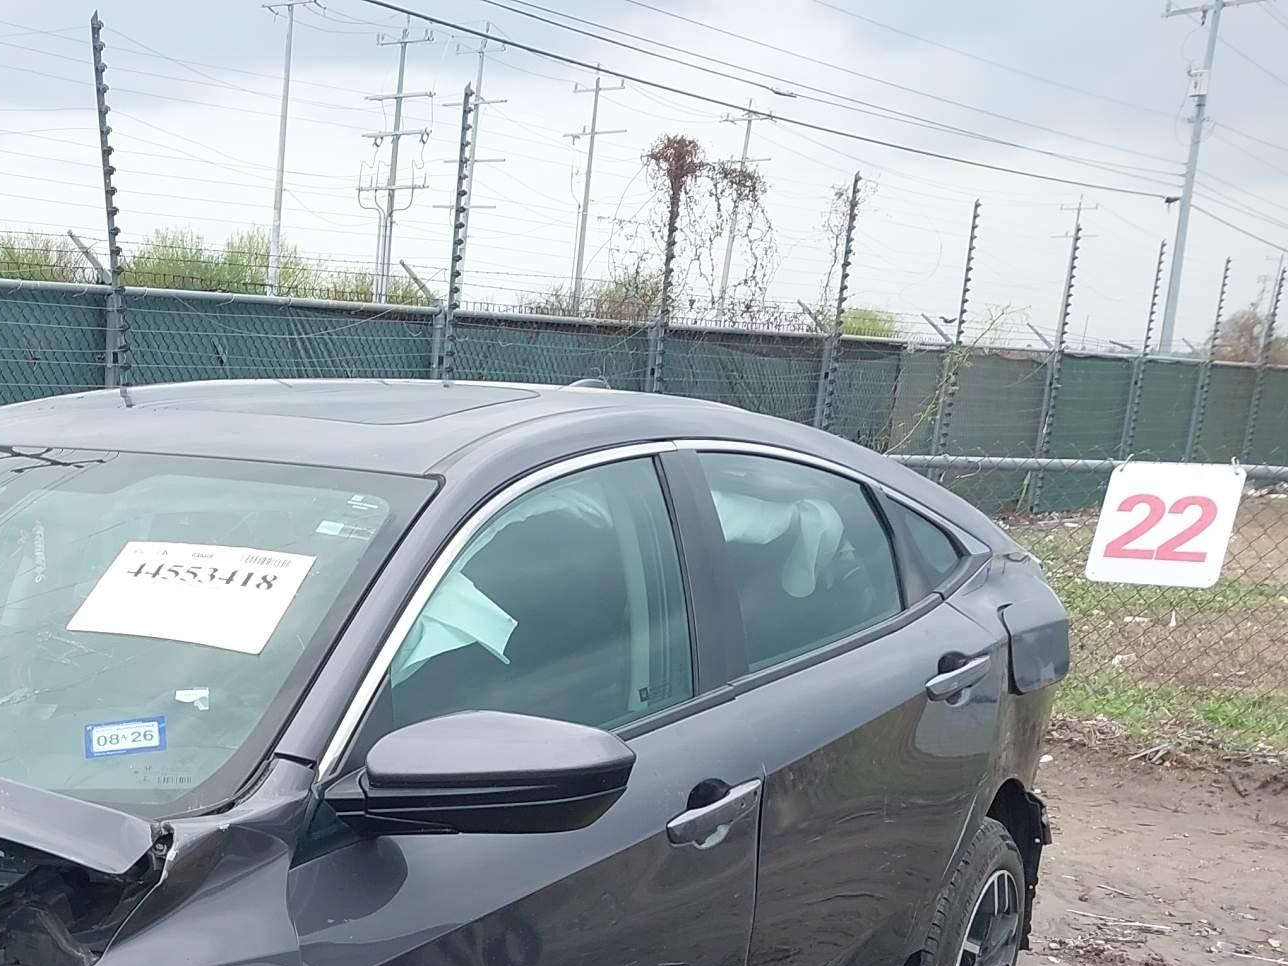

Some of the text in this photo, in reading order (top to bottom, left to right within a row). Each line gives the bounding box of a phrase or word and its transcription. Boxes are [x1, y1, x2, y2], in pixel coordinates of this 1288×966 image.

[1103, 493, 1218, 563] 22
[127, 562, 278, 591] 44553418
[97, 729, 155, 747] 08 26
